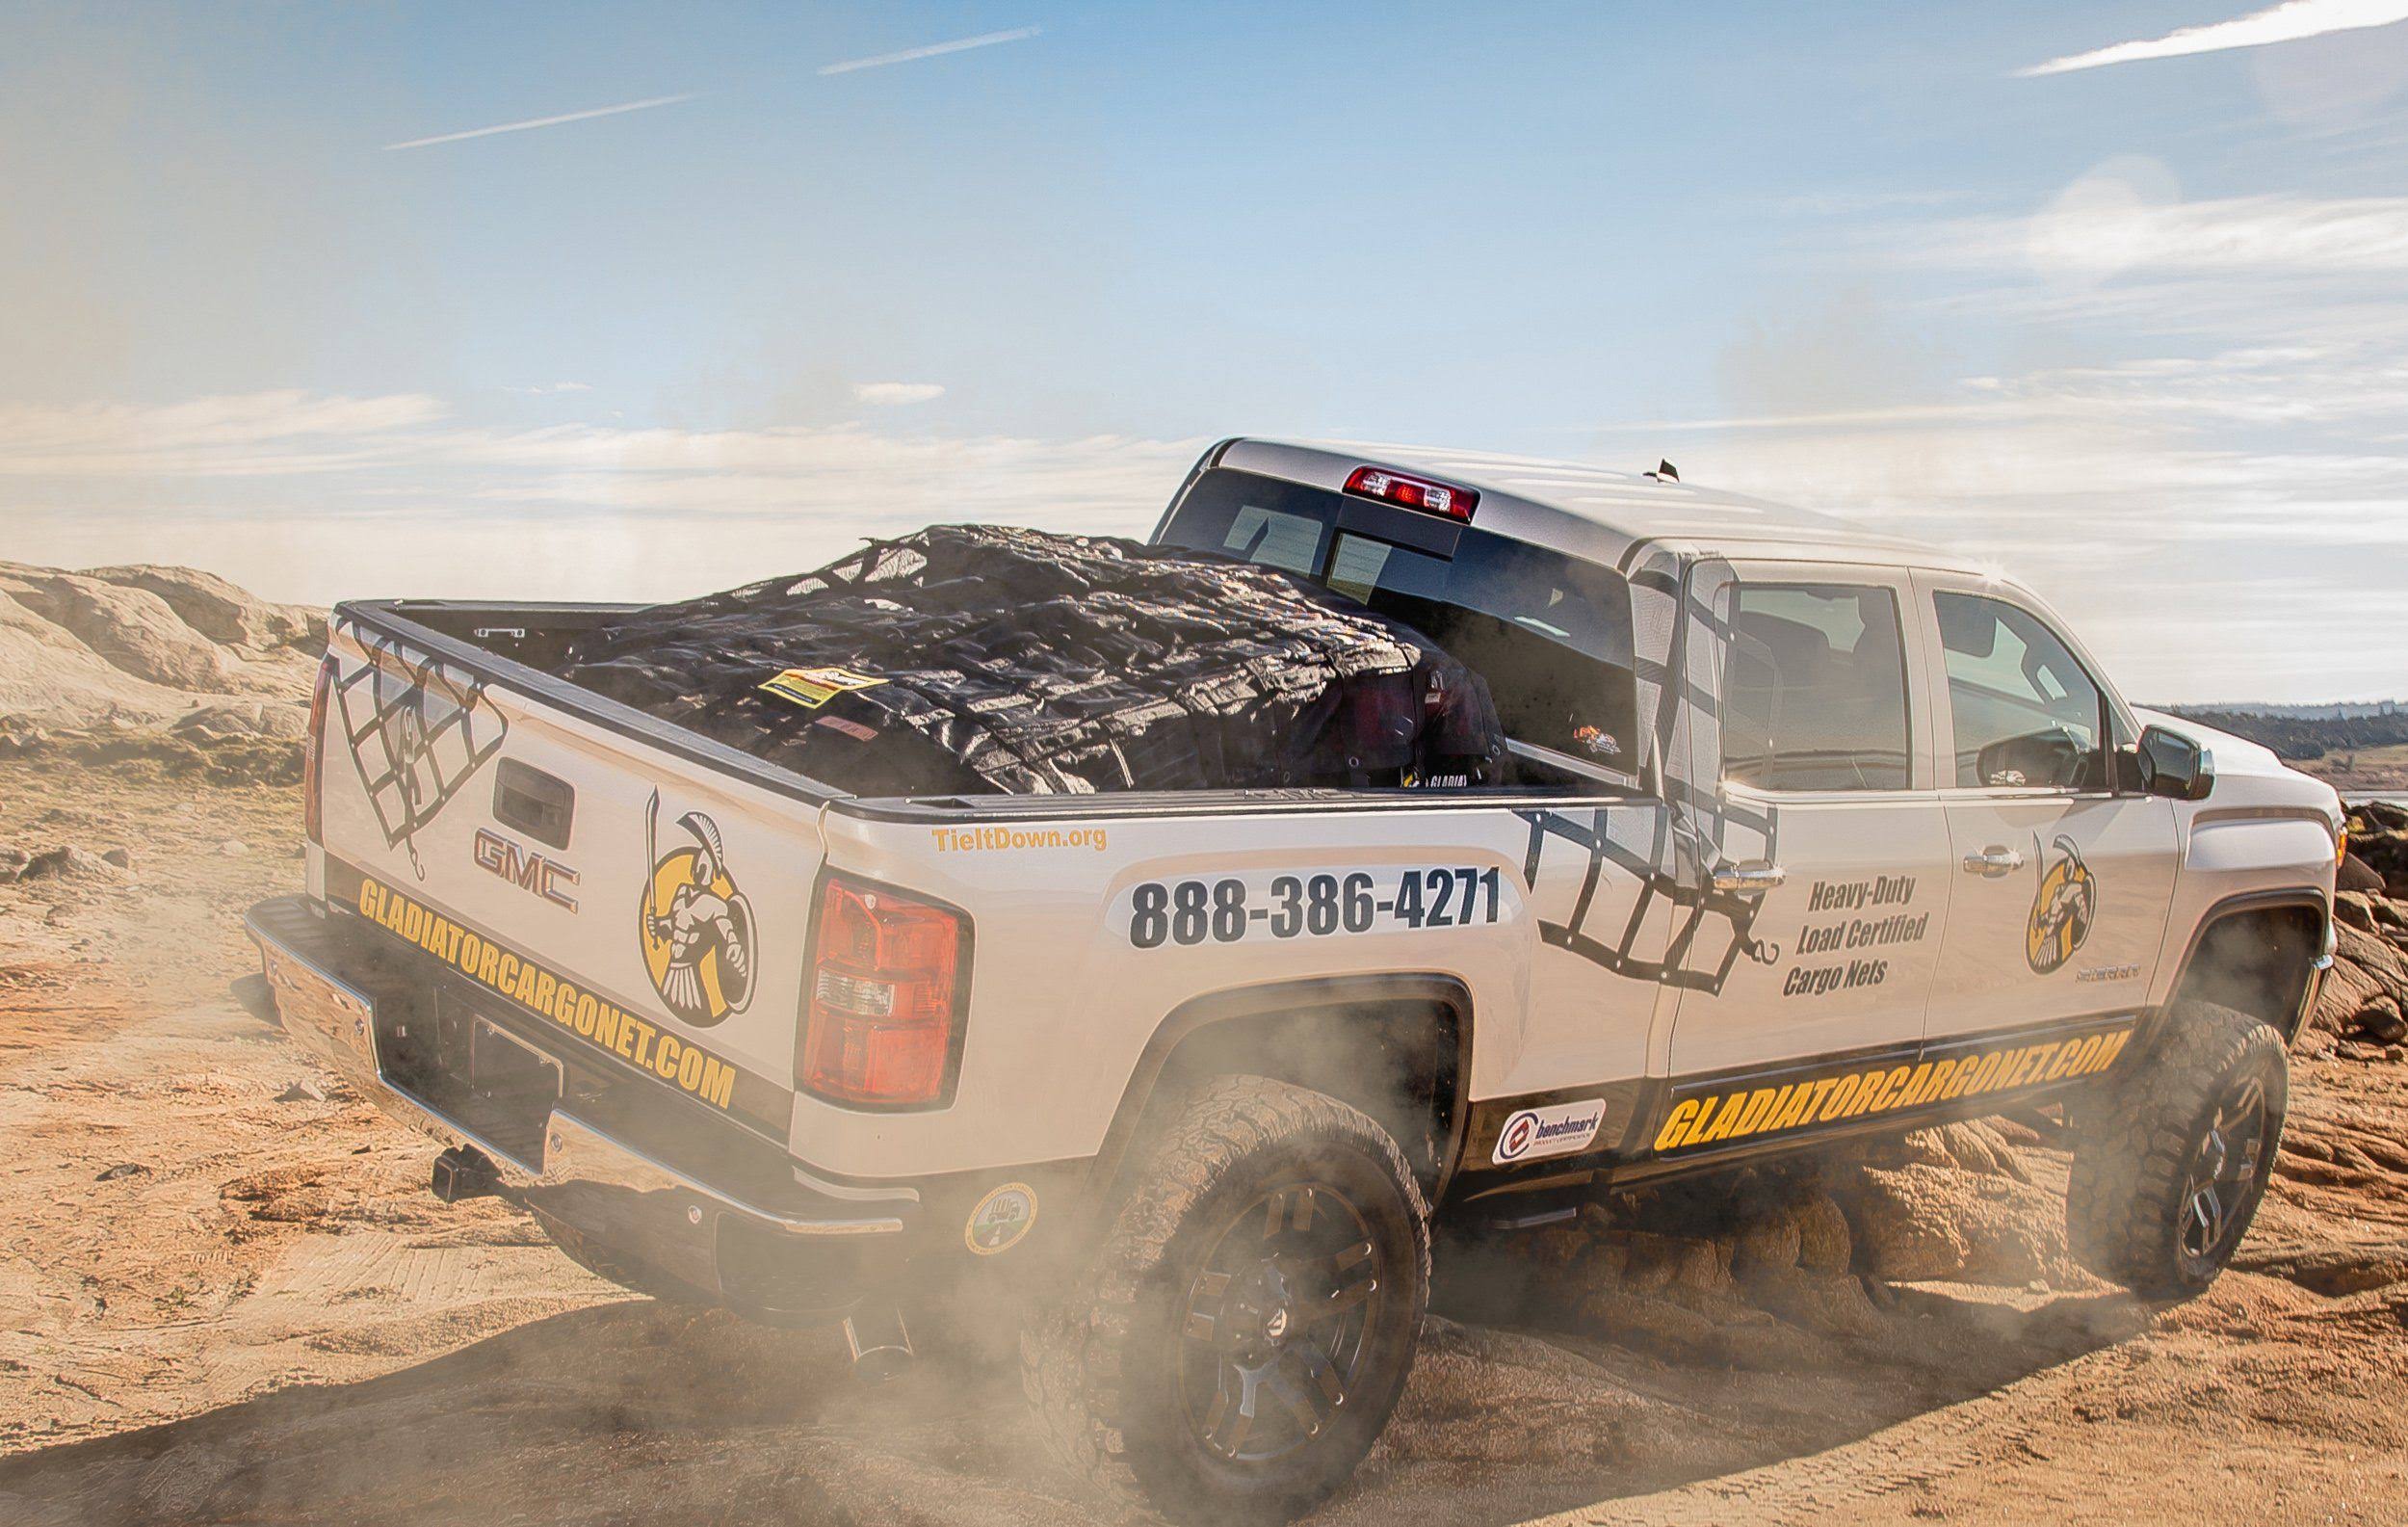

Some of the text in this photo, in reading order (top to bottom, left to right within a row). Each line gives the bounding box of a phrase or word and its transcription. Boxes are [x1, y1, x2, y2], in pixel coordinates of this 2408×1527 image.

[473, 827, 581, 915] GMC
[1807, 875, 1917, 912] Heavy-Duty
[1129, 865, 1501, 949] 888-386-4271
[1795, 911, 1930, 956] Load Certified
[358, 878, 737, 1110] GLADIATORCARGONET.COM
[1782, 959, 1889, 997] Cargo Nets
[1653, 1028, 2135, 1152] GLADIATORCARGONET.COM
[1535, 1111, 1599, 1140] benchmark
